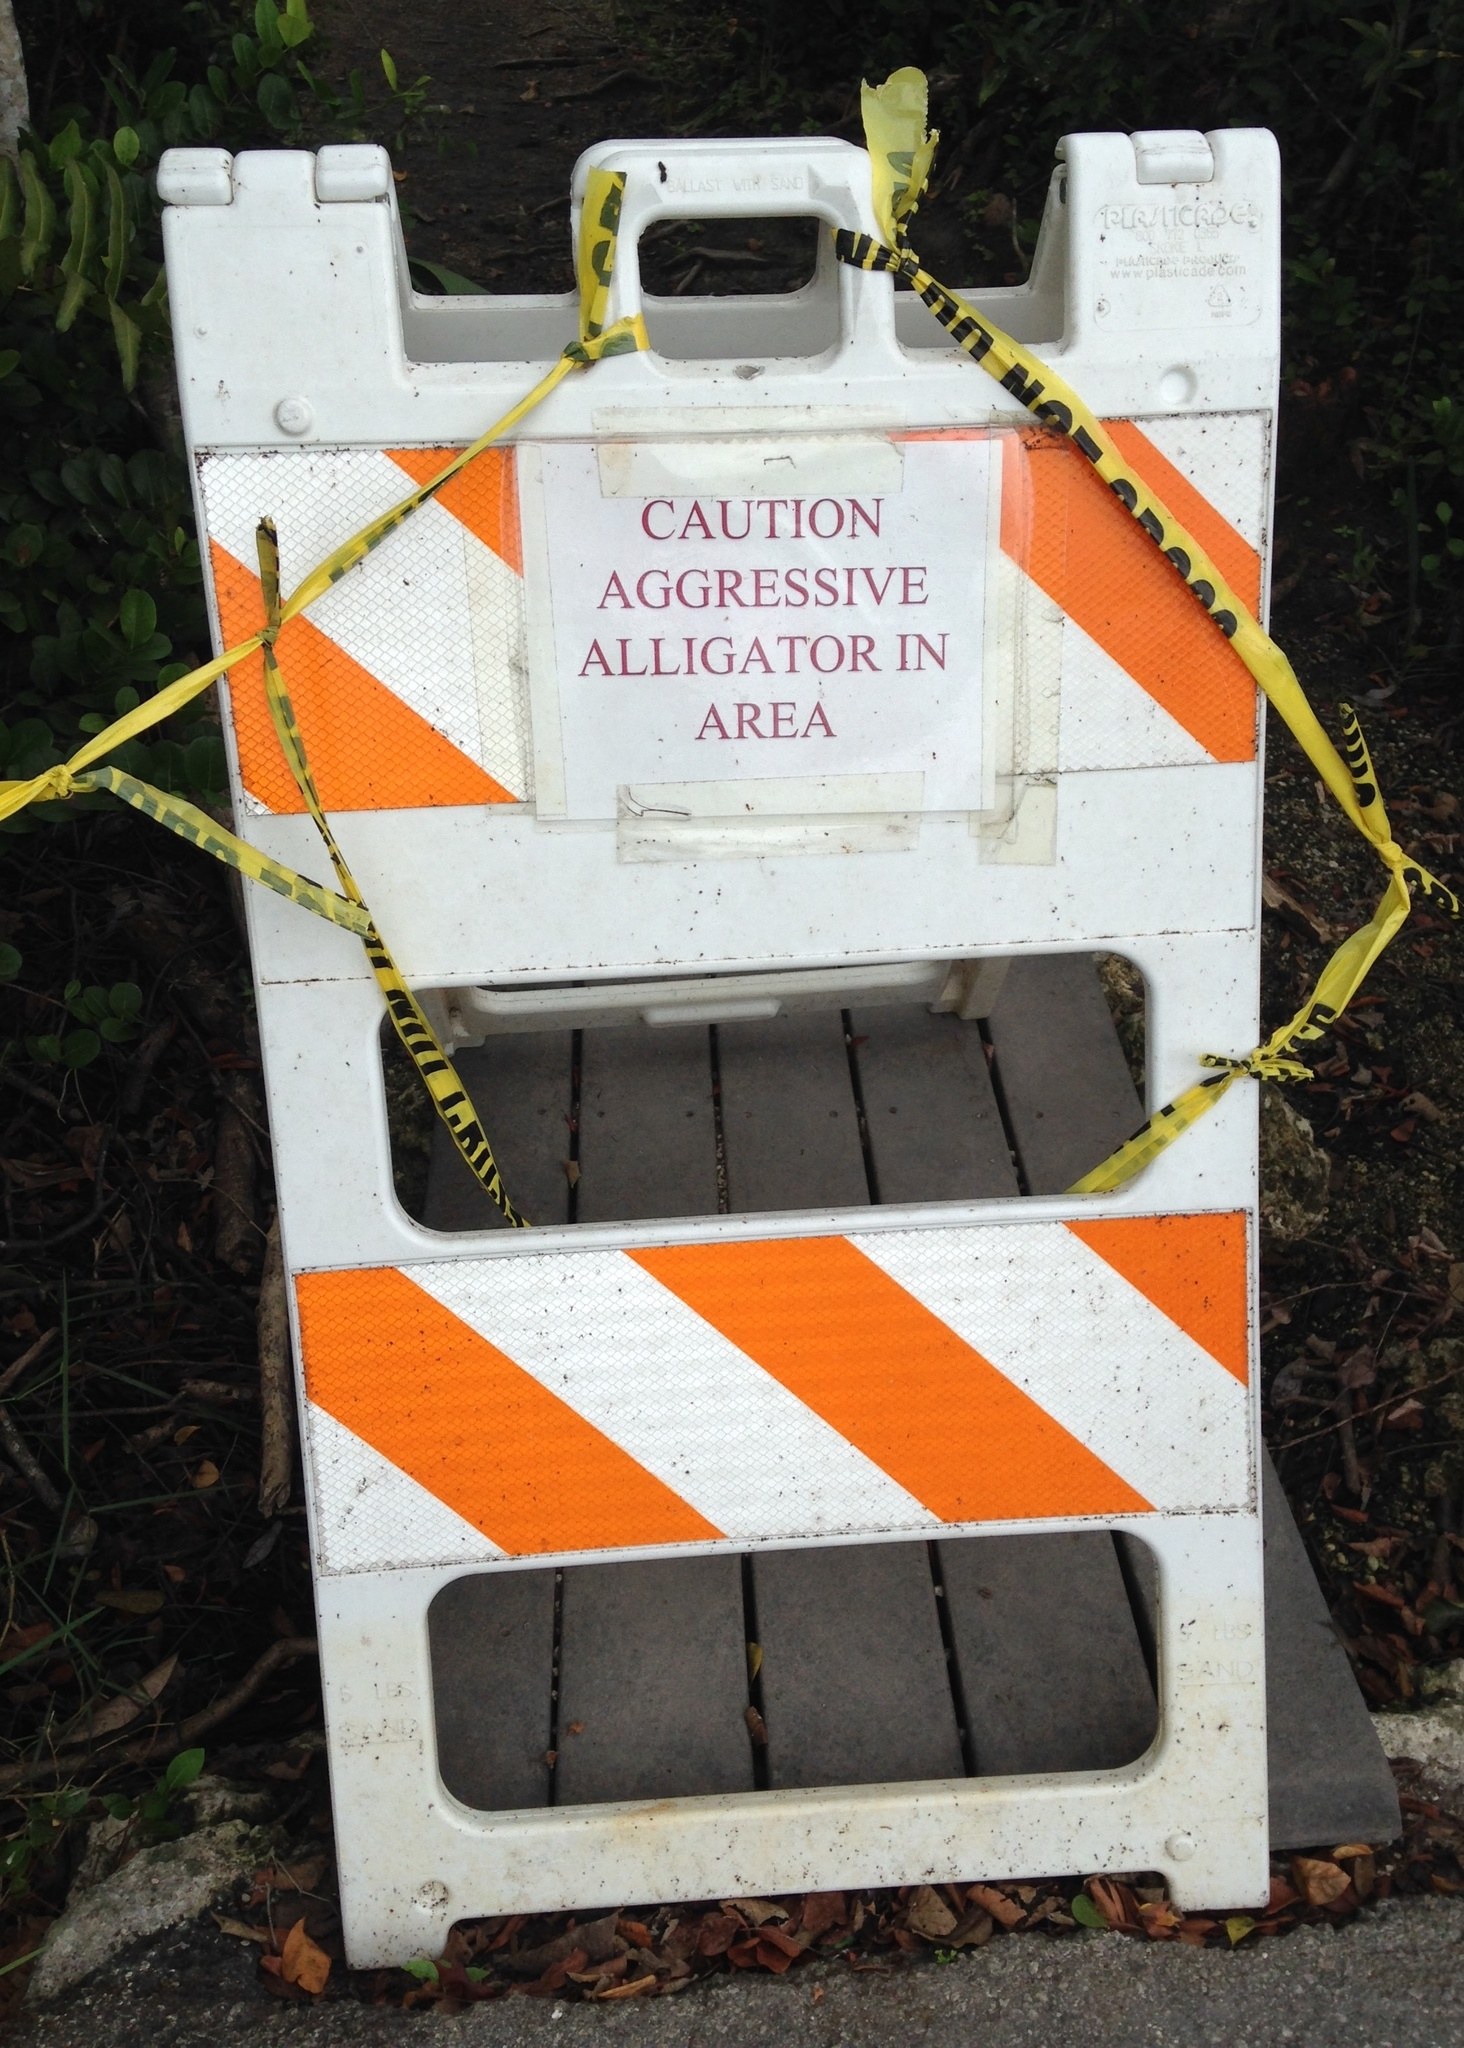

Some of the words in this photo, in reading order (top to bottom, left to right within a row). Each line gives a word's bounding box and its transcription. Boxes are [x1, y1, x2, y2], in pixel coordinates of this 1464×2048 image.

[641, 498, 885, 540] CAUTION
[597, 567, 930, 610] AGGRESSIVE
[577, 634, 882, 677] ALLIGATOR
[896, 633, 950, 672] IN
[694, 701, 838, 742] AREA
